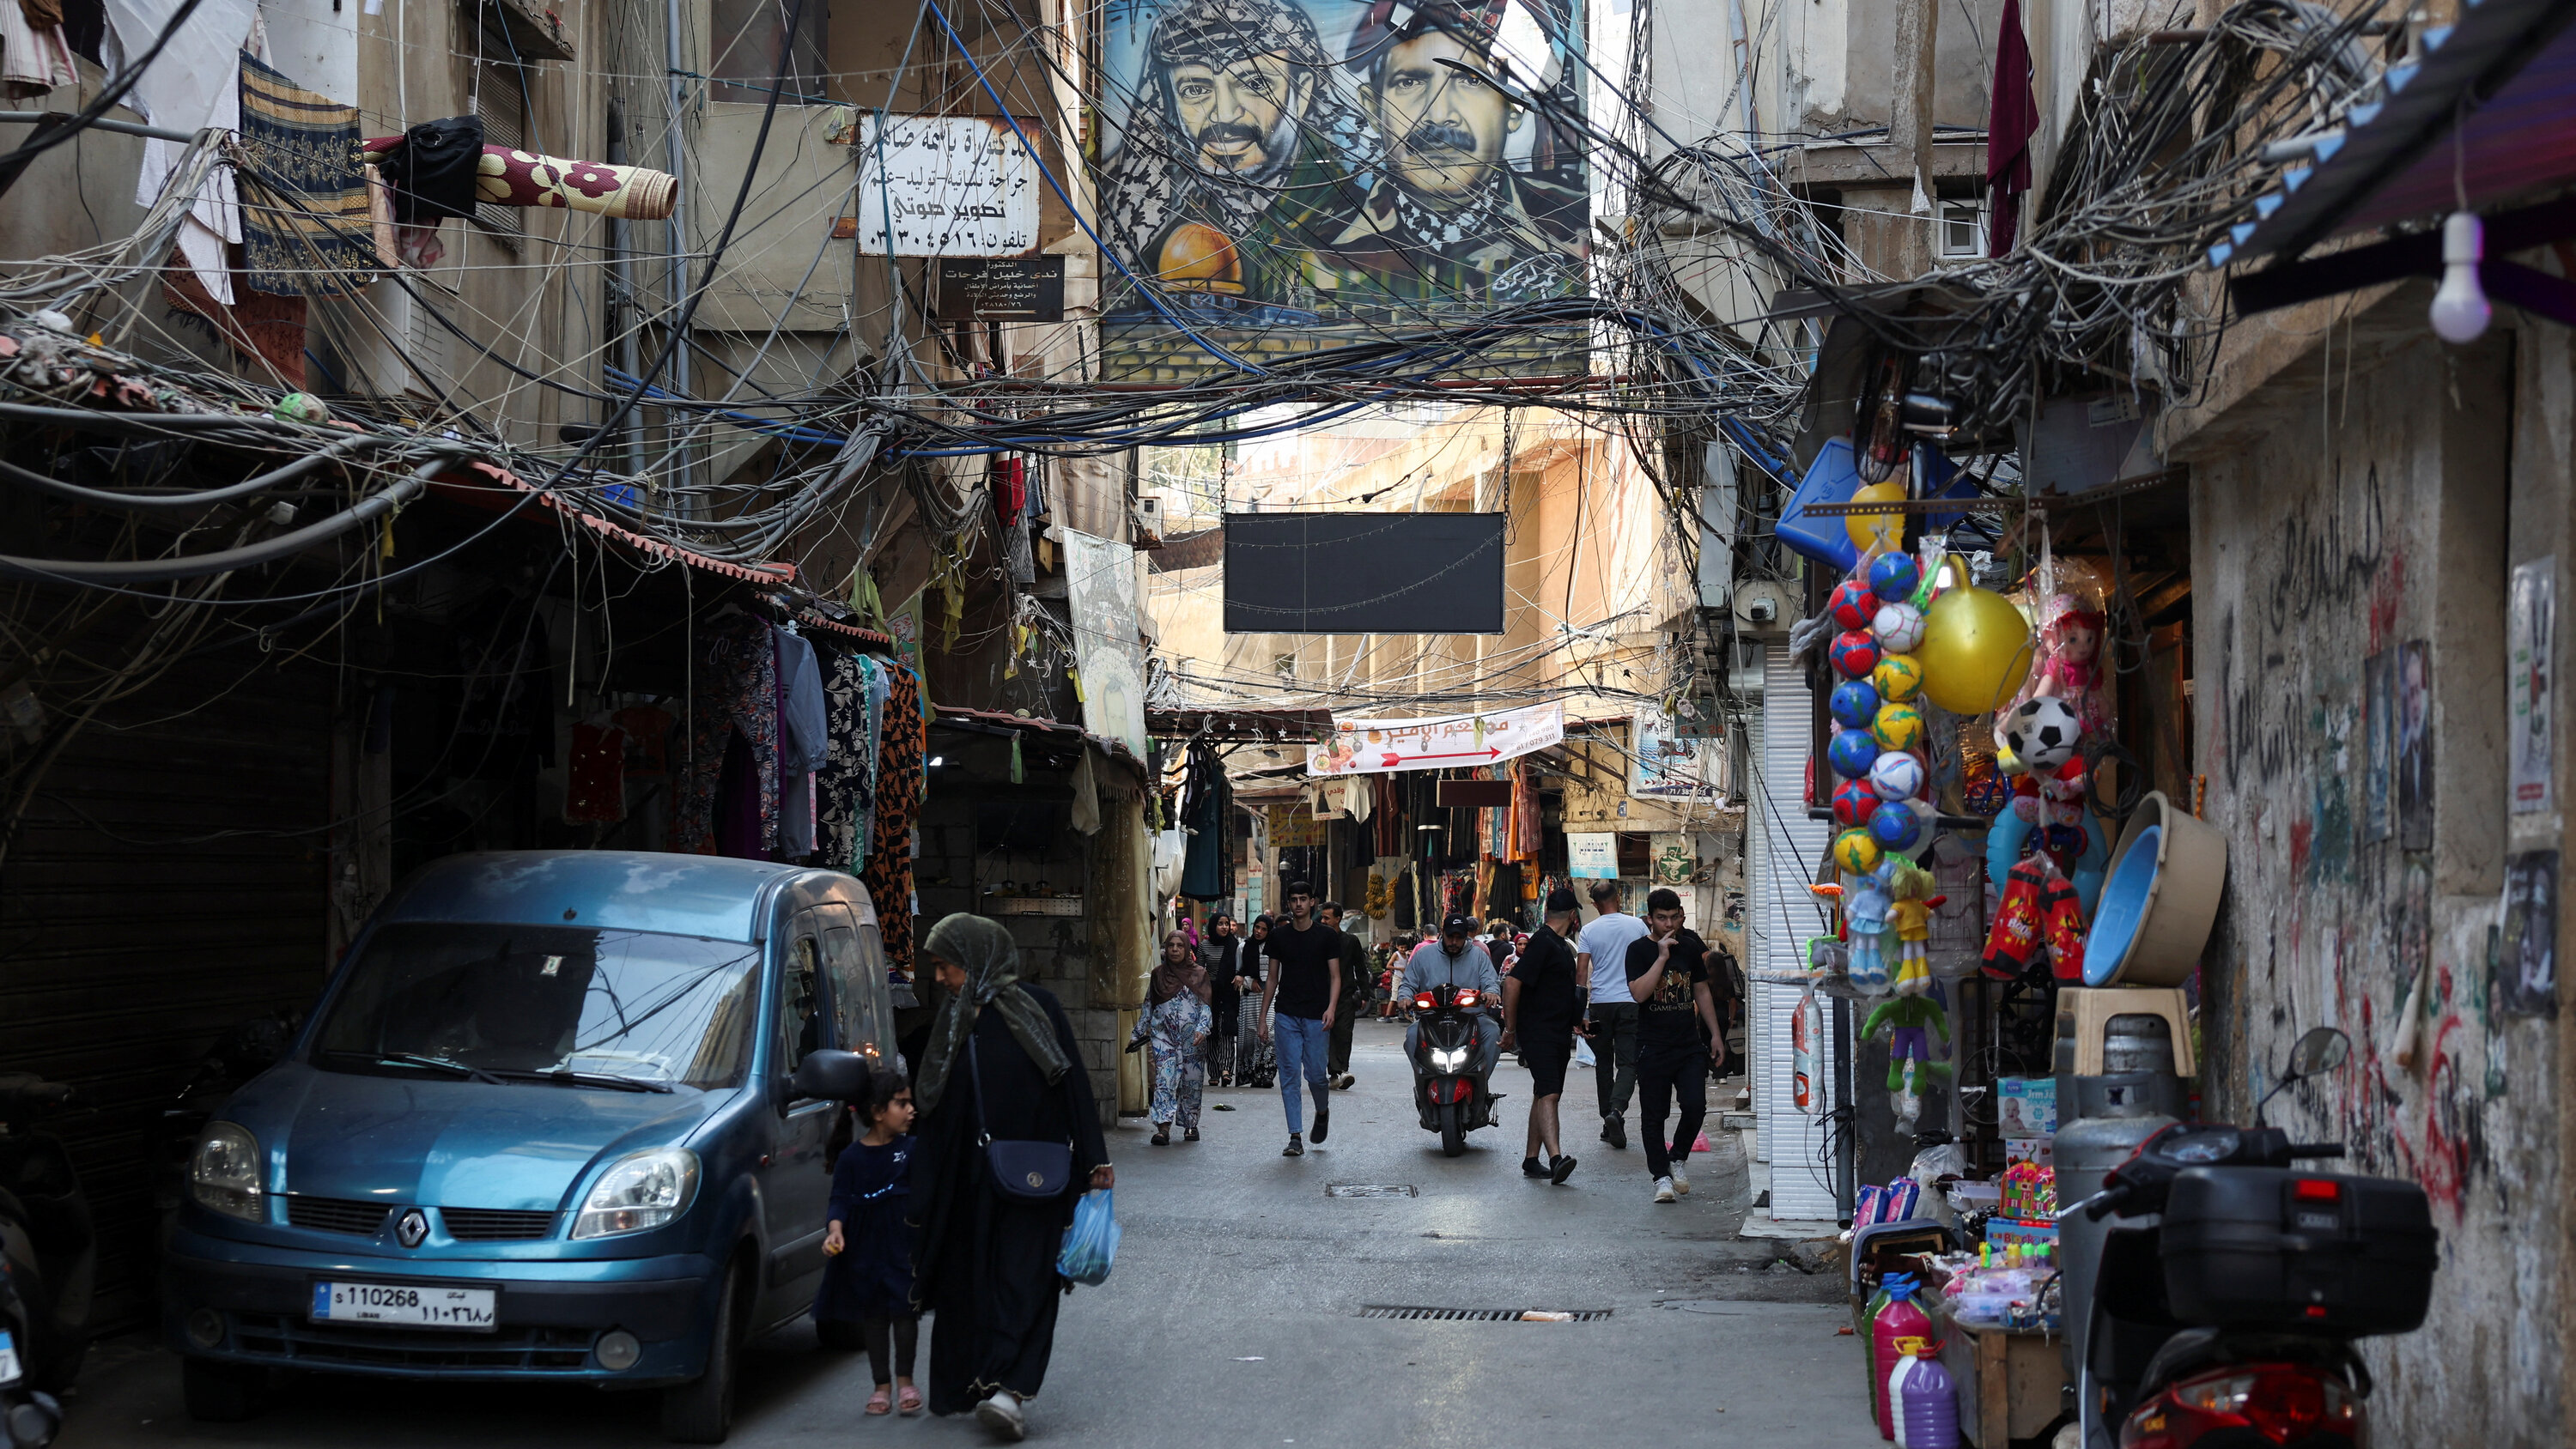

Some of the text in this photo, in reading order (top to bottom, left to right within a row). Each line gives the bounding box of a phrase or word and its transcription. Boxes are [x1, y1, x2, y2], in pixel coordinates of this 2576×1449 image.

[1723, 98, 1732, 110] KN
[988, 168, 1027, 197] جراحة
[892, 196, 1006, 224] تصوير صوتي
[945, 270, 1058, 280] ندى خليل فرحات
[1530, 737, 1542, 746] 079
[1544, 733, 1555, 742] 311
[348, 1287, 420, 1307] 110268
